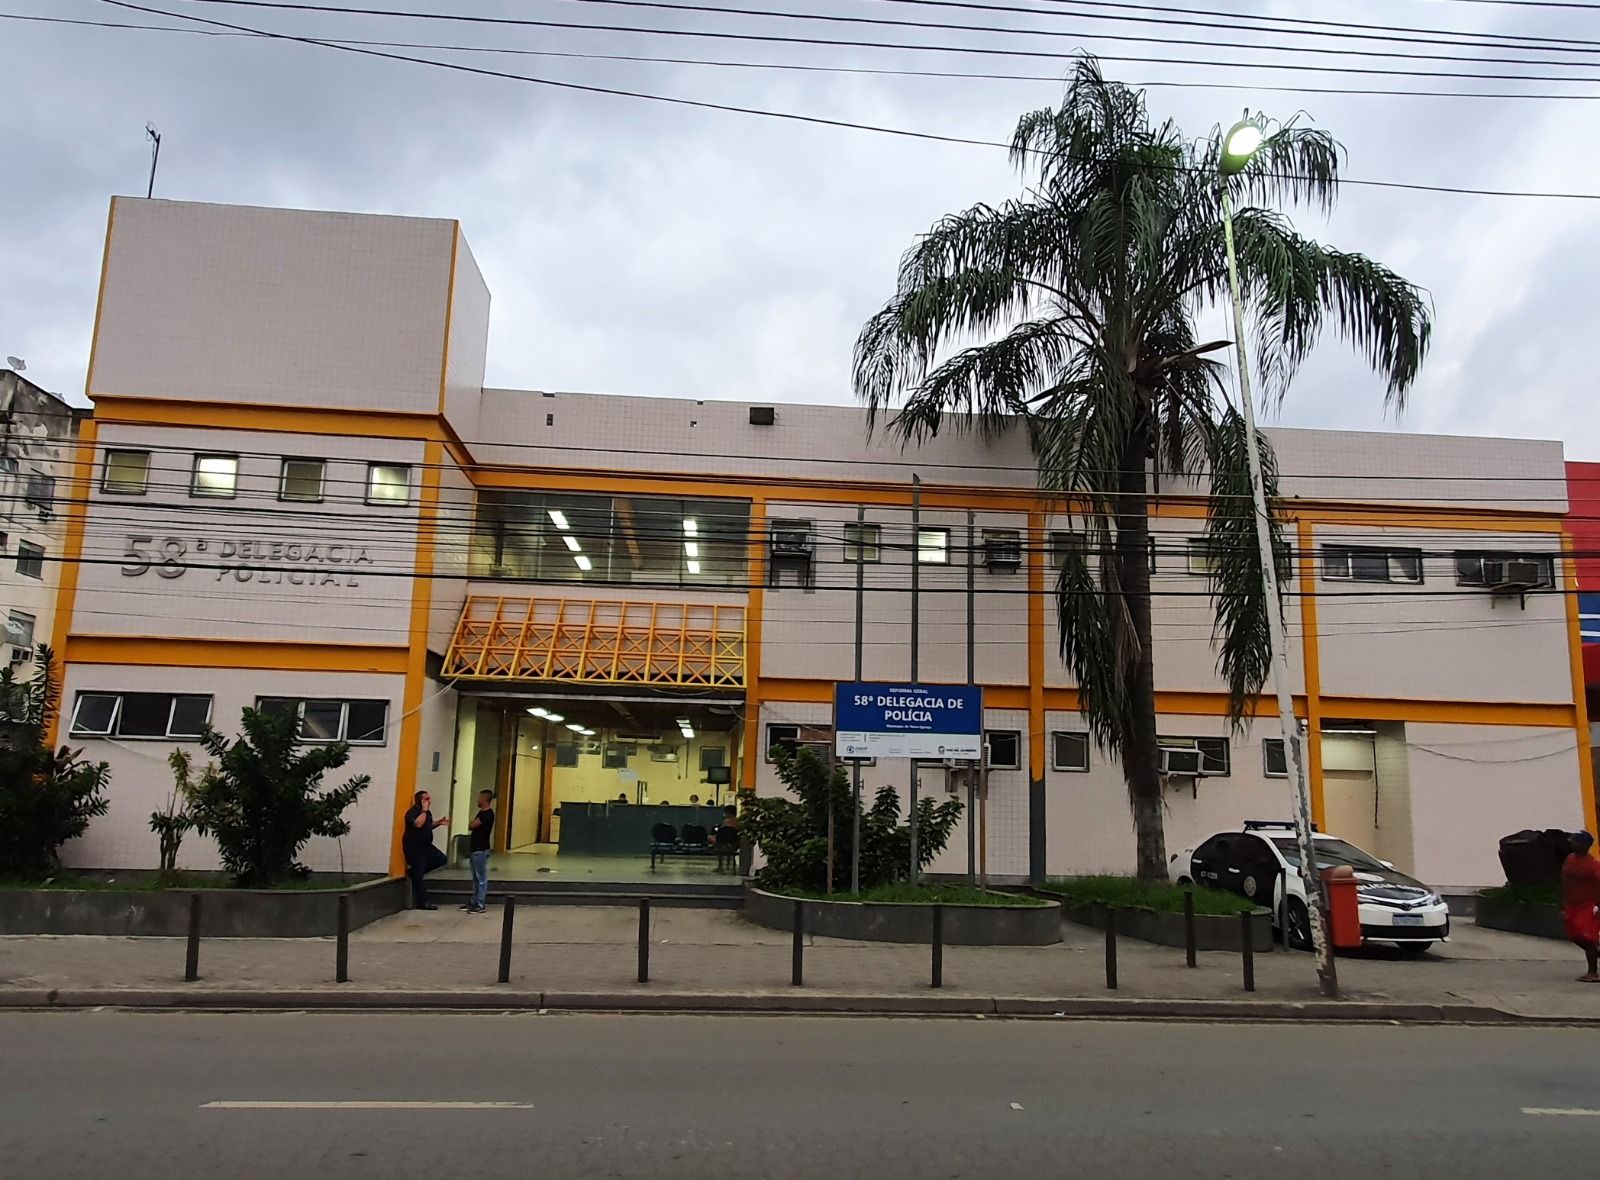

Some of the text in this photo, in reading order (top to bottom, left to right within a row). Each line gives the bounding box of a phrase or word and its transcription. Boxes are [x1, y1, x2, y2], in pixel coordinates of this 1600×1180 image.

[218, 540, 374, 565] DELEGACIA
[216, 563, 360, 588] POLICIAL
[854, 695, 964, 709] 58ª DELEGACIA DE
[884, 708, 933, 722] POLÍCIA
